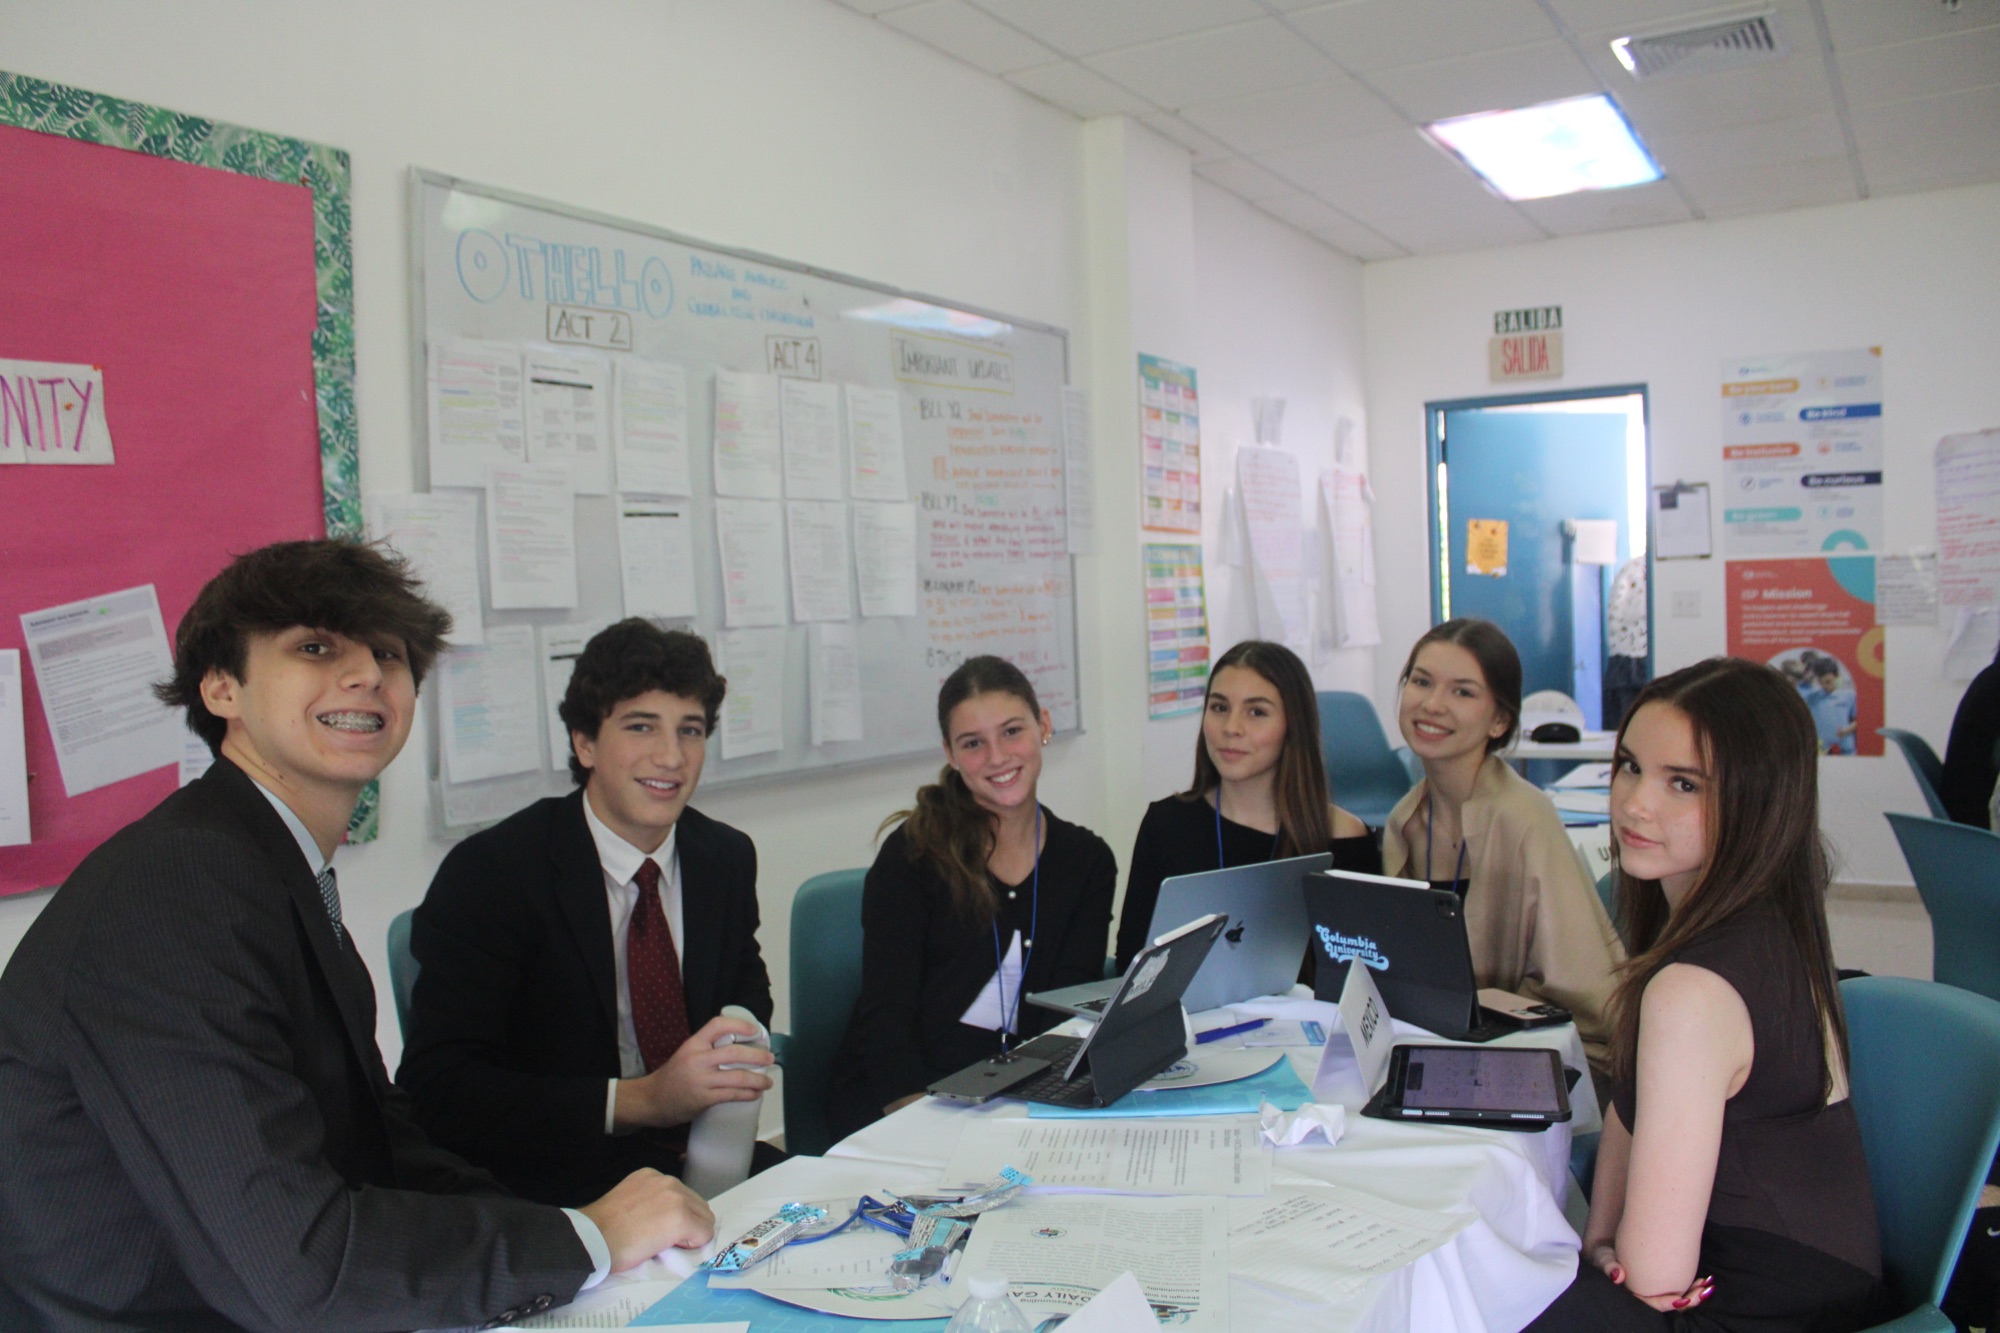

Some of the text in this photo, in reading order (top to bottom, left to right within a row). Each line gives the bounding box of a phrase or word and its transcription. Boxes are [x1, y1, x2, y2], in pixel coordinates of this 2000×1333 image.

[455, 227, 674, 319] OTHELLO
[554, 309, 627, 345] ACT 2
[1495, 305, 1562, 334] SALIDA
[773, 340, 817, 375] ACT 4
[1502, 335, 1550, 375] SALIDA
[0, 374, 93, 452] NITY
[1762, 587, 1813, 599] Mission
[1315, 924, 1380, 962] Columbia University
[1359, 996, 1379, 1049] MEXICO
[1044, 1291, 1091, 1304] DAILY
